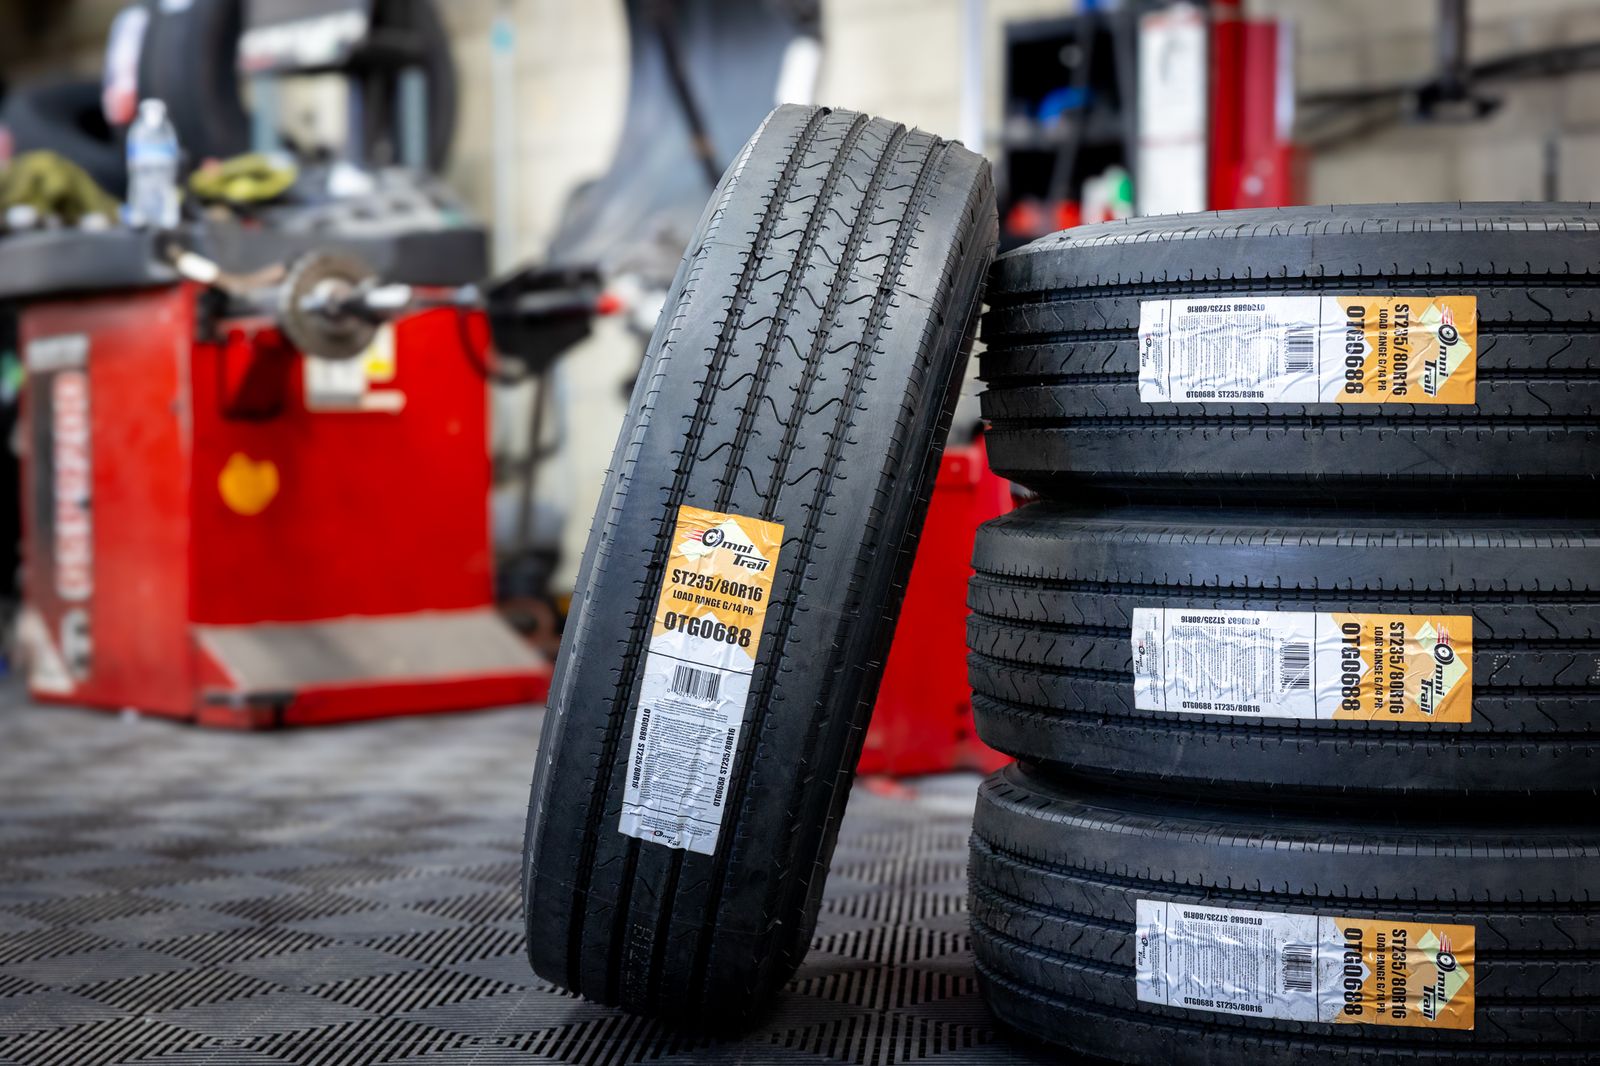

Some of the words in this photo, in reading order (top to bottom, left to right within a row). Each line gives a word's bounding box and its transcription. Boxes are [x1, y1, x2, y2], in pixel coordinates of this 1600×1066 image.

[1379, 309, 1388, 329] LOAD
[1378, 332, 1387, 357] RANGE
[1393, 304, 1409, 395] ST235/80R16
[1438, 325, 1459, 377] Omni
[1378, 359, 1386, 377] G/14
[1424, 360, 1437, 396] Trail
[1378, 380, 1386, 391] PR
[702, 529, 754, 553] Omni
[733, 553, 769, 571] Trail
[672, 569, 763, 602] ST235/80R16
[673, 590, 693, 602] LOAD
[695, 595, 720, 608] RANGE
[723, 601, 741, 613] G/14
[743, 606, 754, 616] PR
[1375, 627, 1383, 646] LOAD
[1375, 649, 1383, 675] RANGE
[1389, 622, 1404, 714] ST235/80R16
[1434, 644, 1454, 695] Omni
[1214, 703, 1260, 712] ST235/80R16
[1375, 698, 1382, 708] PR
[1421, 679, 1433, 714] Trail
[720, 728, 735, 775] ST235/80R16
[632, 743, 645, 788] ST235/80R16
[1377, 933, 1385, 952] LOAD
[1377, 955, 1385, 981] RANGE
[1392, 929, 1406, 1018] ST235/80R16
[1436, 952, 1456, 1002] Omni
[1377, 983, 1385, 1000] G/14
[1423, 986, 1435, 1020] Trail
[1377, 1003, 1385, 1013] PR
